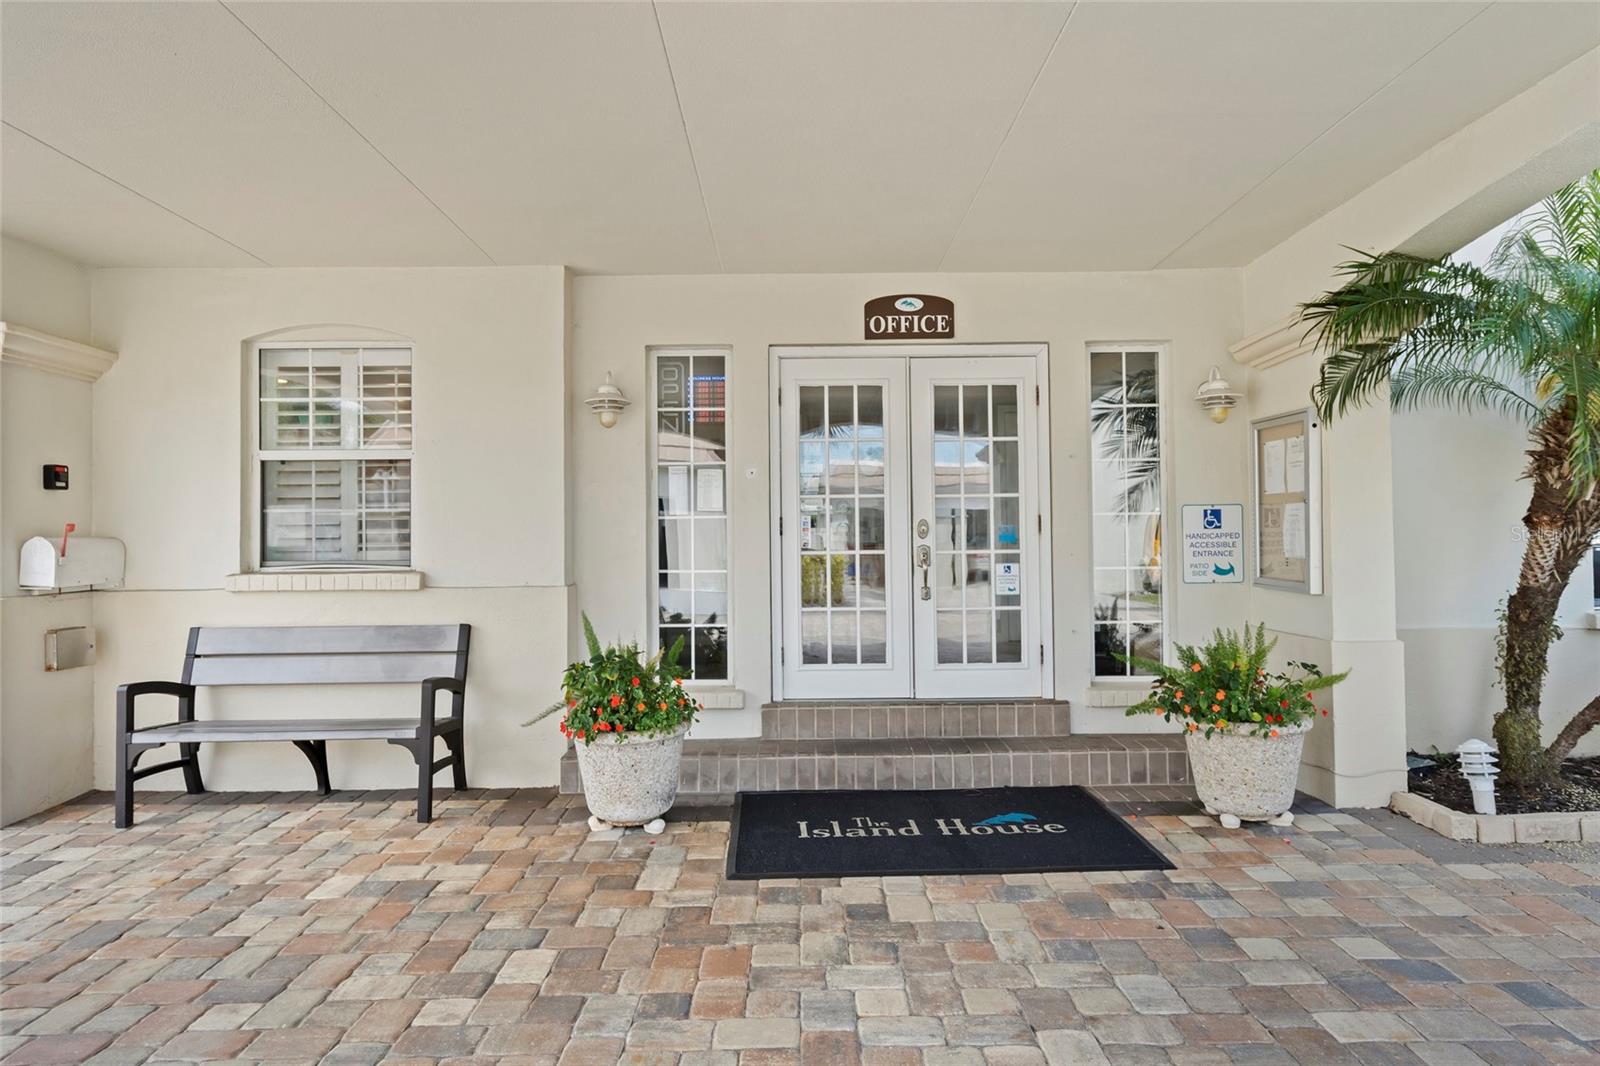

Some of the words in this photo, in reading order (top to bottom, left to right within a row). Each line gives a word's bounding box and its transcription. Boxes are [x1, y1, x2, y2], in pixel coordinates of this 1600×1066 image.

[869, 315, 949, 333] OFFICE
[1185, 532, 1241, 540] HANDICAPPED
[1189, 541, 1237, 549] ACCESSIBLE
[1192, 550, 1234, 558] ENTRANCE
[852, 816, 890, 828] The
[797, 819, 923, 838] Island
[935, 818, 1068, 836] House
